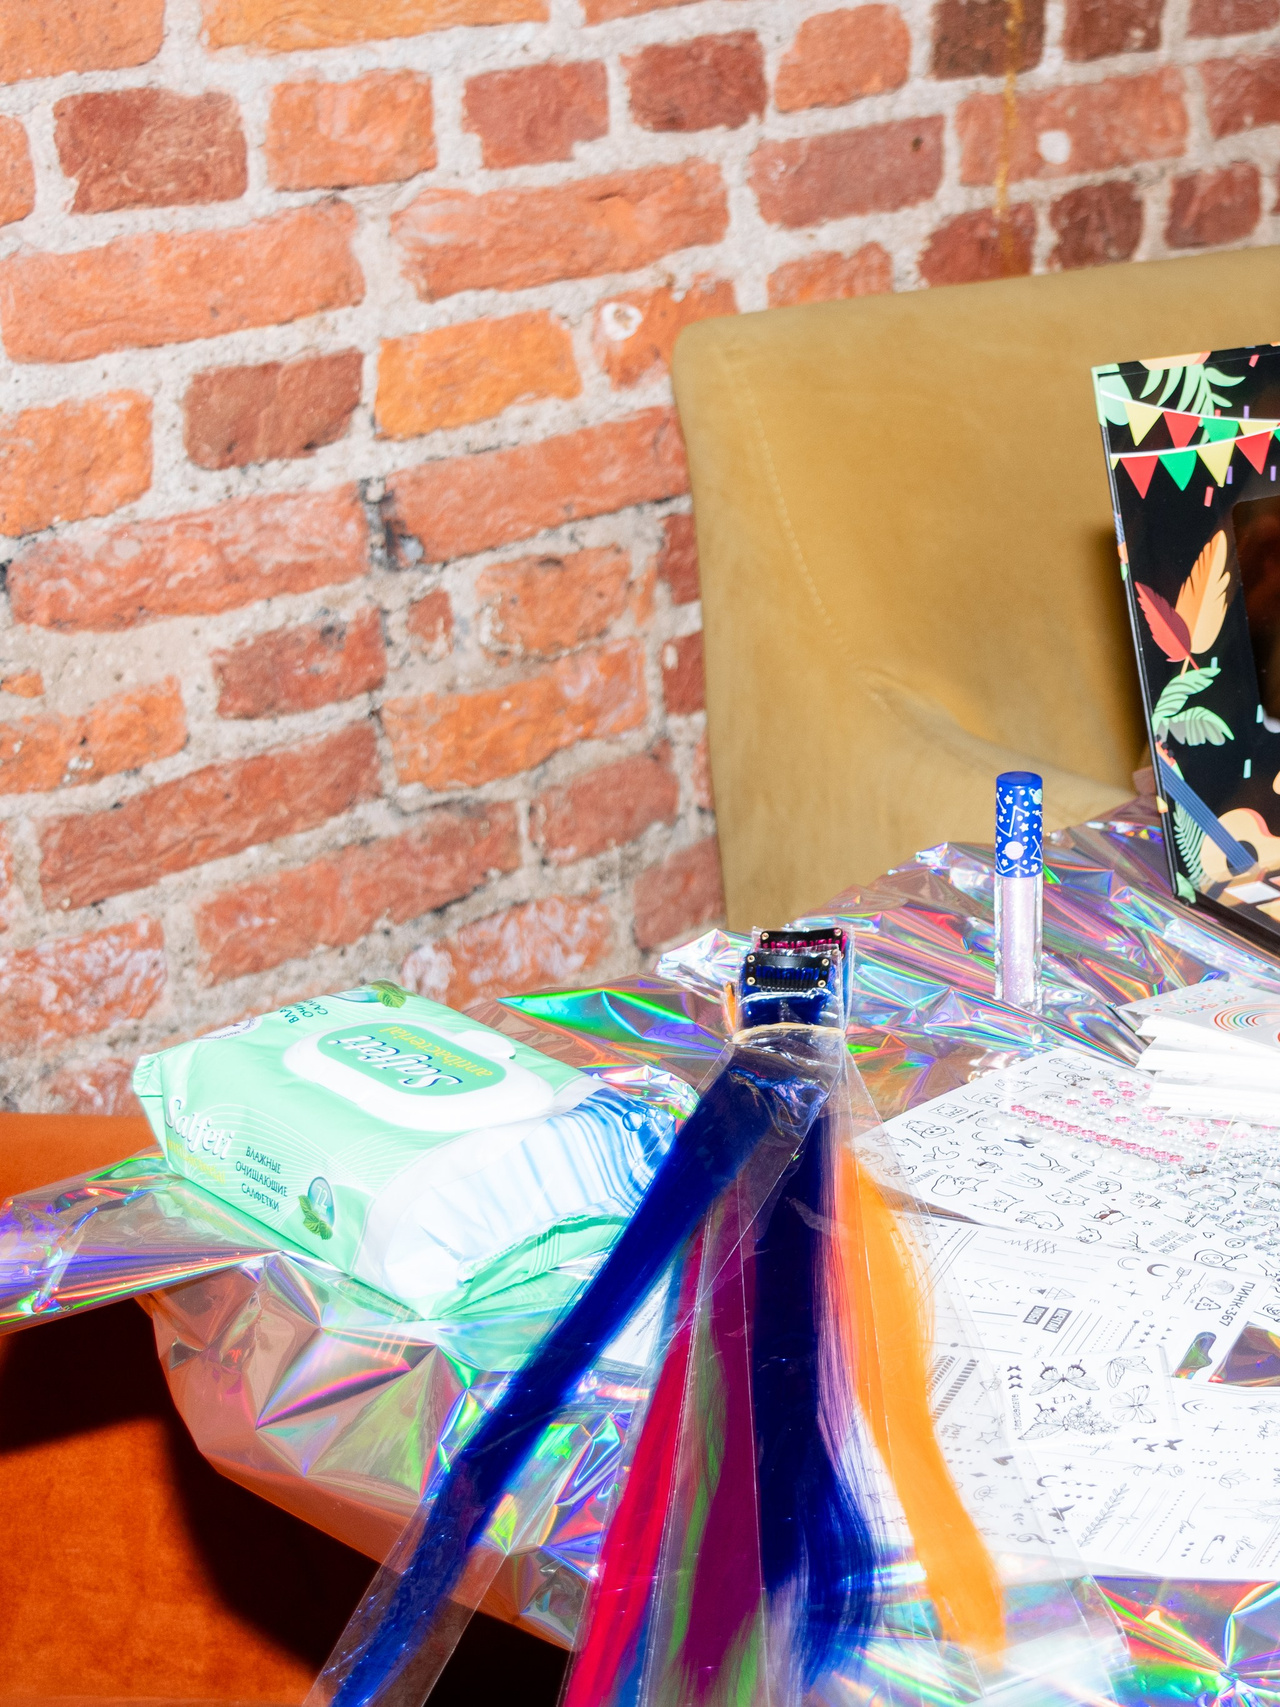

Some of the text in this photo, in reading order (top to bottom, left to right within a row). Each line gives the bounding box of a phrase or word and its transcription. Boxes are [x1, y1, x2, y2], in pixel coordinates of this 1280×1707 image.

[327, 1035, 463, 1088] Salfeti
[378, 1026, 493, 1077] antibacterial
[165, 1096, 235, 1160] Salfeti
[245, 1146, 281, 1174] ВЛАЖНЫЕ
[241, 1183, 280, 1212] САЛФЕТКИ
[1219, 1281, 1256, 1327] ПИНК-367
